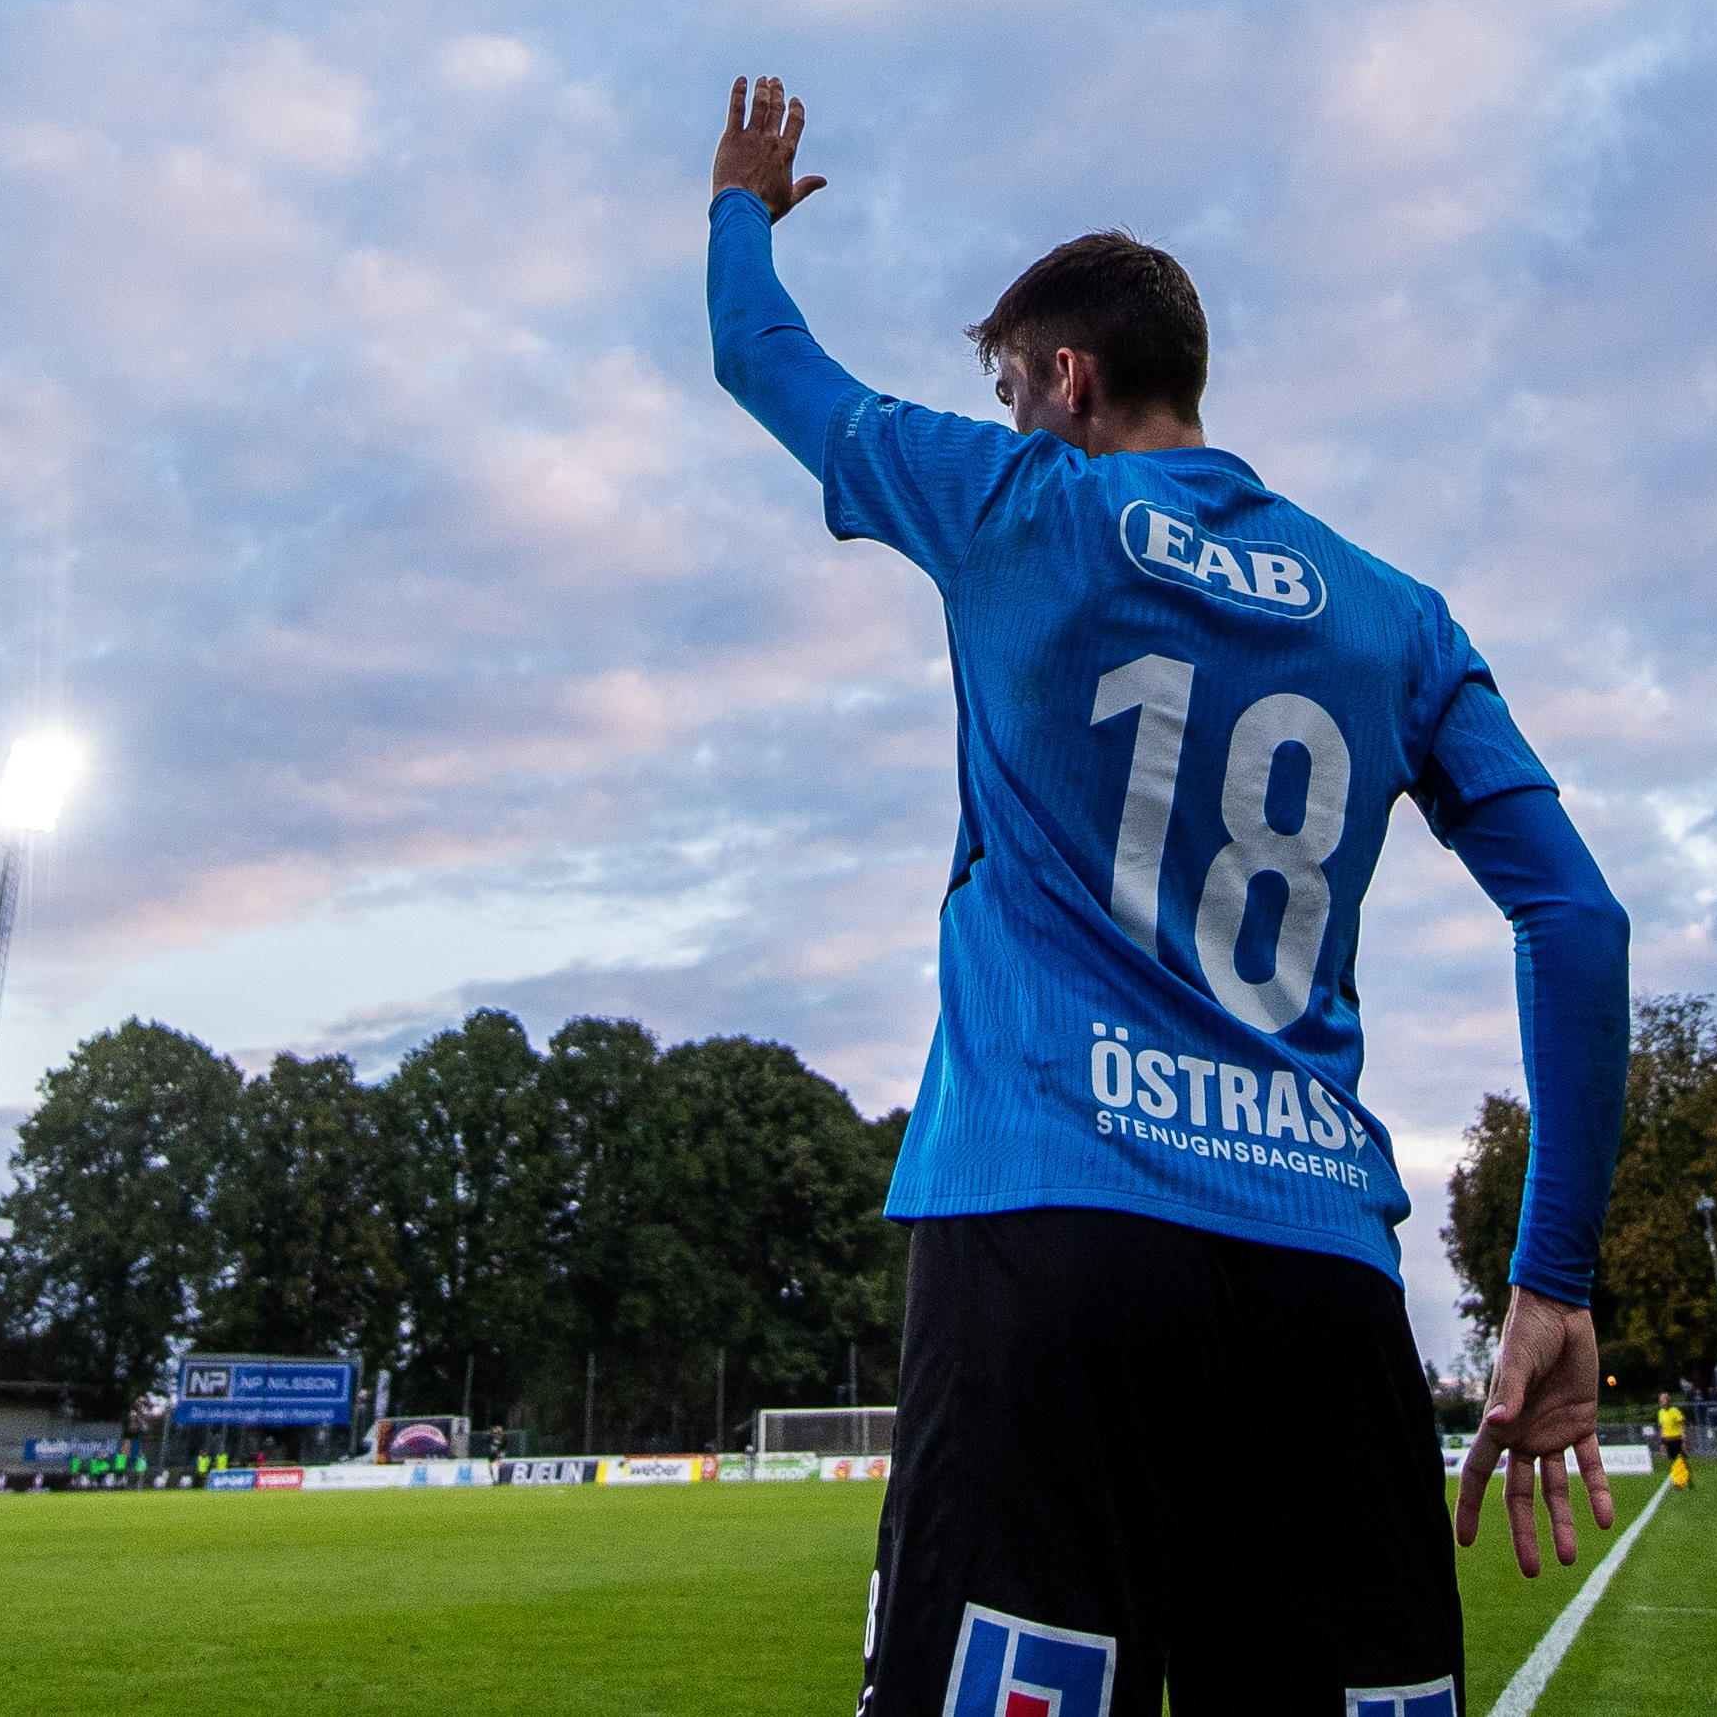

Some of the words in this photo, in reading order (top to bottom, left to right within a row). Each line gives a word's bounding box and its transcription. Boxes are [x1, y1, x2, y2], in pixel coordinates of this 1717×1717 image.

[1141, 505, 1311, 611] EAB
[1090, 654, 1350, 1035] 18
[1091, 1023, 1347, 1150] ÖSTRAS
[1097, 1110, 1369, 1191] STENUGNSBAGERIET
[191, 1371, 227, 1393] NP
[267, 1376, 337, 1391] NILSSON
[511, 1462, 584, 1485] BJELIN
[629, 1458, 682, 1478] weber
